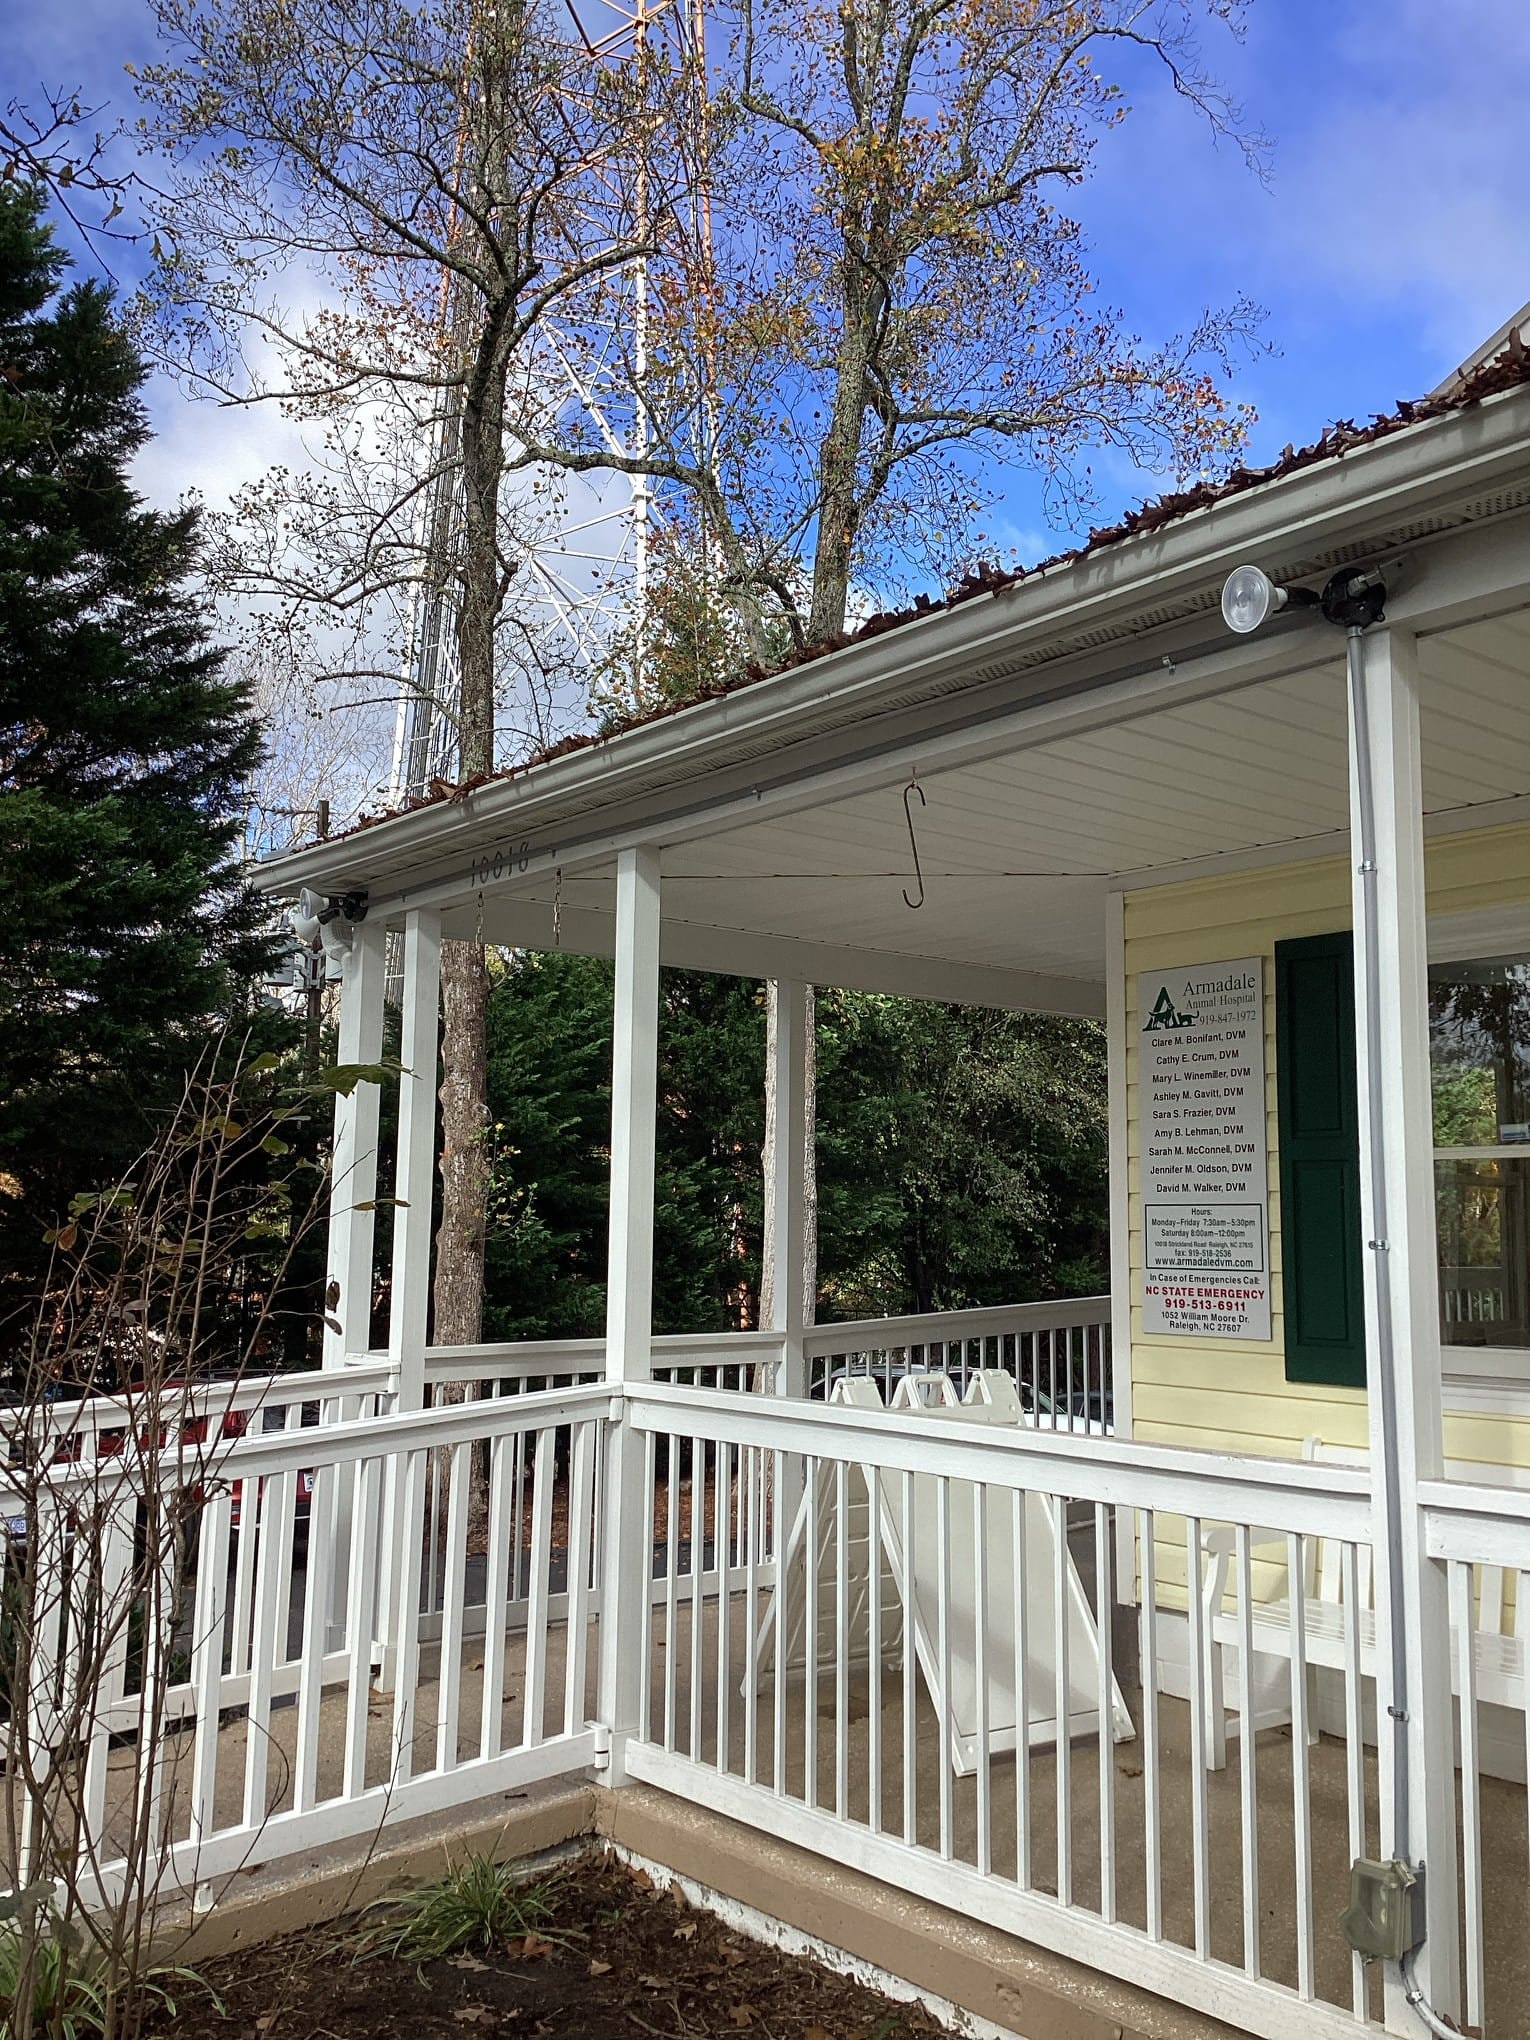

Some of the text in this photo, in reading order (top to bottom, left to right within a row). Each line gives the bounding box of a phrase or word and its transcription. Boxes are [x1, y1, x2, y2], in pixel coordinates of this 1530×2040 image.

[1183, 973, 1256, 996] Armadale
[1186, 991, 1256, 1010] Animal Hospital
[1151, 1030, 1246, 1048] Clare M. Bonifant, DVM
[1156, 1053, 1180, 1065] Cathy
[1192, 1052, 1217, 1062] Crum,
[1219, 1049, 1239, 1060] DVM
[1152, 1074, 1172, 1084] Mary
[1230, 1067, 1251, 1078] DVM
[1153, 1091, 1180, 1102] Ashley
[1182, 1090, 1192, 1099] M.
[1223, 1087, 1244, 1097] DVM
[1152, 1106, 1236, 1120] Sara S. Frazier, DVM
[1154, 1125, 1244, 1139] Amy B. Lehman, DVM
[1148, 1143, 1255, 1156] Sarah M. McConnell, DVM
[1150, 1162, 1252, 1175] Jennifer M. Oldson, DVM
[1156, 1182, 1246, 1193] David M. Walker, DVM
[1191, 1207, 1213, 1216] Hours:
[1161, 1228, 1189, 1239] Saturday
[1155, 1257, 1254, 1268] www.armadaledvm.com
[1150, 1273, 1157, 1281] In
[1158, 1273, 1178, 1282] Case
[1180, 1274, 1187, 1282] of
[1188, 1275, 1242, 1285] Emergencies
[1145, 1286, 1265, 1300] NC STATE EMERGENCY
[1165, 1298, 1246, 1312] 919-513-6911
[1161, 1311, 1179, 1319] 1052
[1181, 1312, 1209, 1321] William
[1211, 1314, 1236, 1323] Moore
[1169, 1320, 1241, 1332] Raleigh, NC 27607
